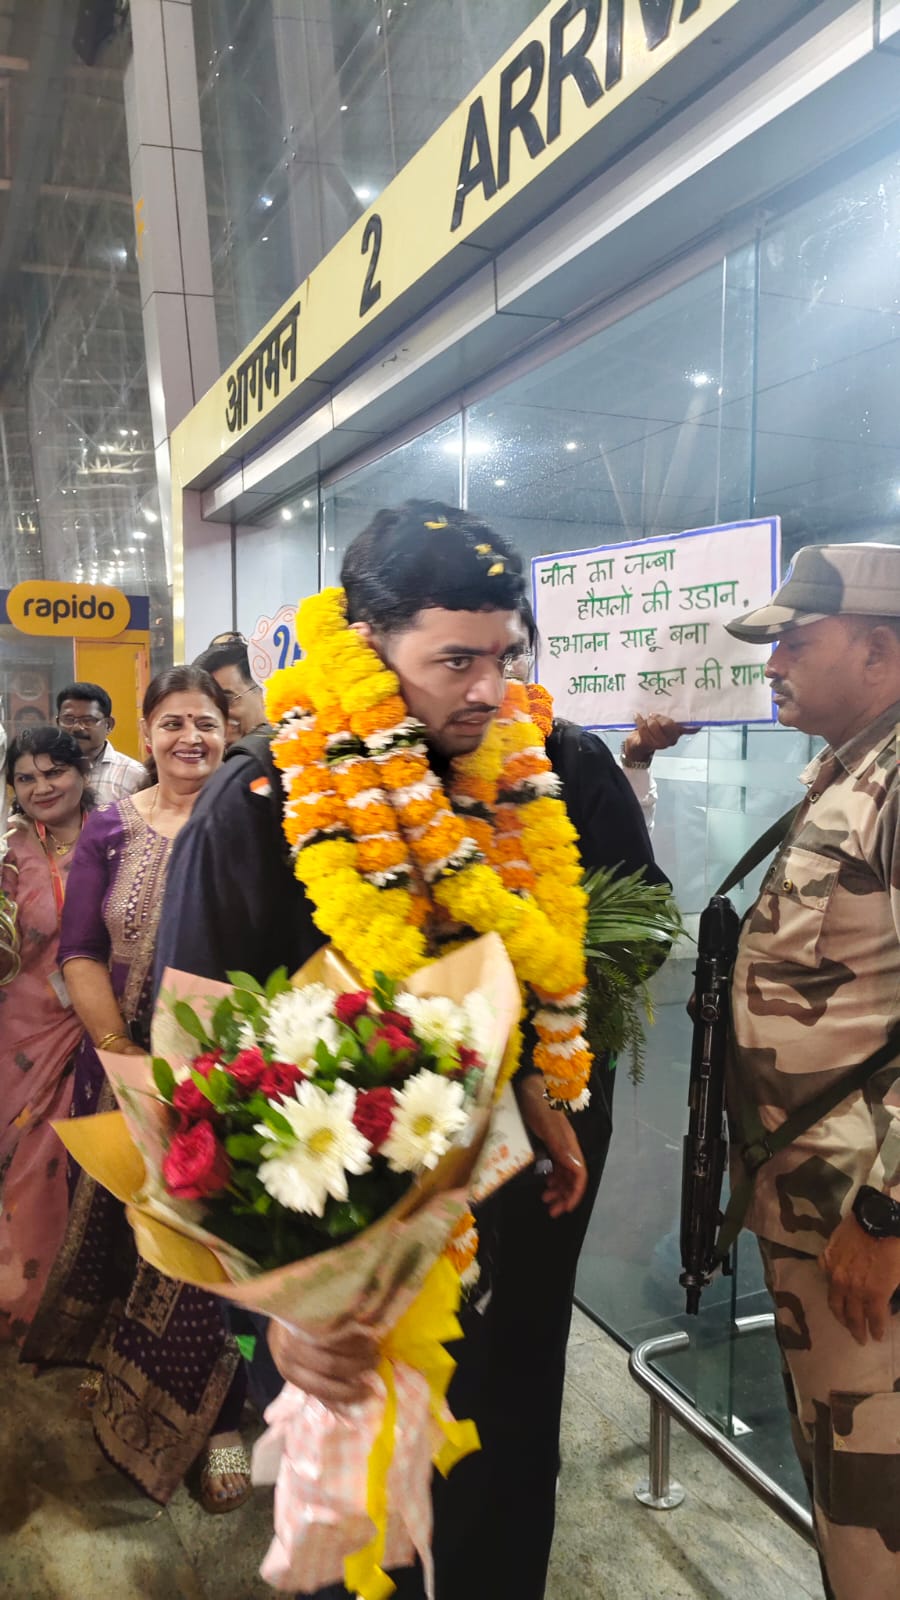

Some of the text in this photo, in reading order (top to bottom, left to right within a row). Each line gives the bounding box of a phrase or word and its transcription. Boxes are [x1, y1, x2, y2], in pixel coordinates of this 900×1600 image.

[225, 301, 301, 432] आगमन
[359, 213, 383, 318] 2
[541, 562, 577, 587] जीत
[586, 558, 615, 584] का
[23, 594, 115, 624] rapido
[577, 584, 633, 621] हौसलों
[641, 580, 672, 614] की
[619, 627, 664, 652] साहू
[669, 622, 710, 645] बना
[637, 667, 687, 696] स्कूल
[694, 657, 723, 691] की
[730, 663, 767, 687] शान
